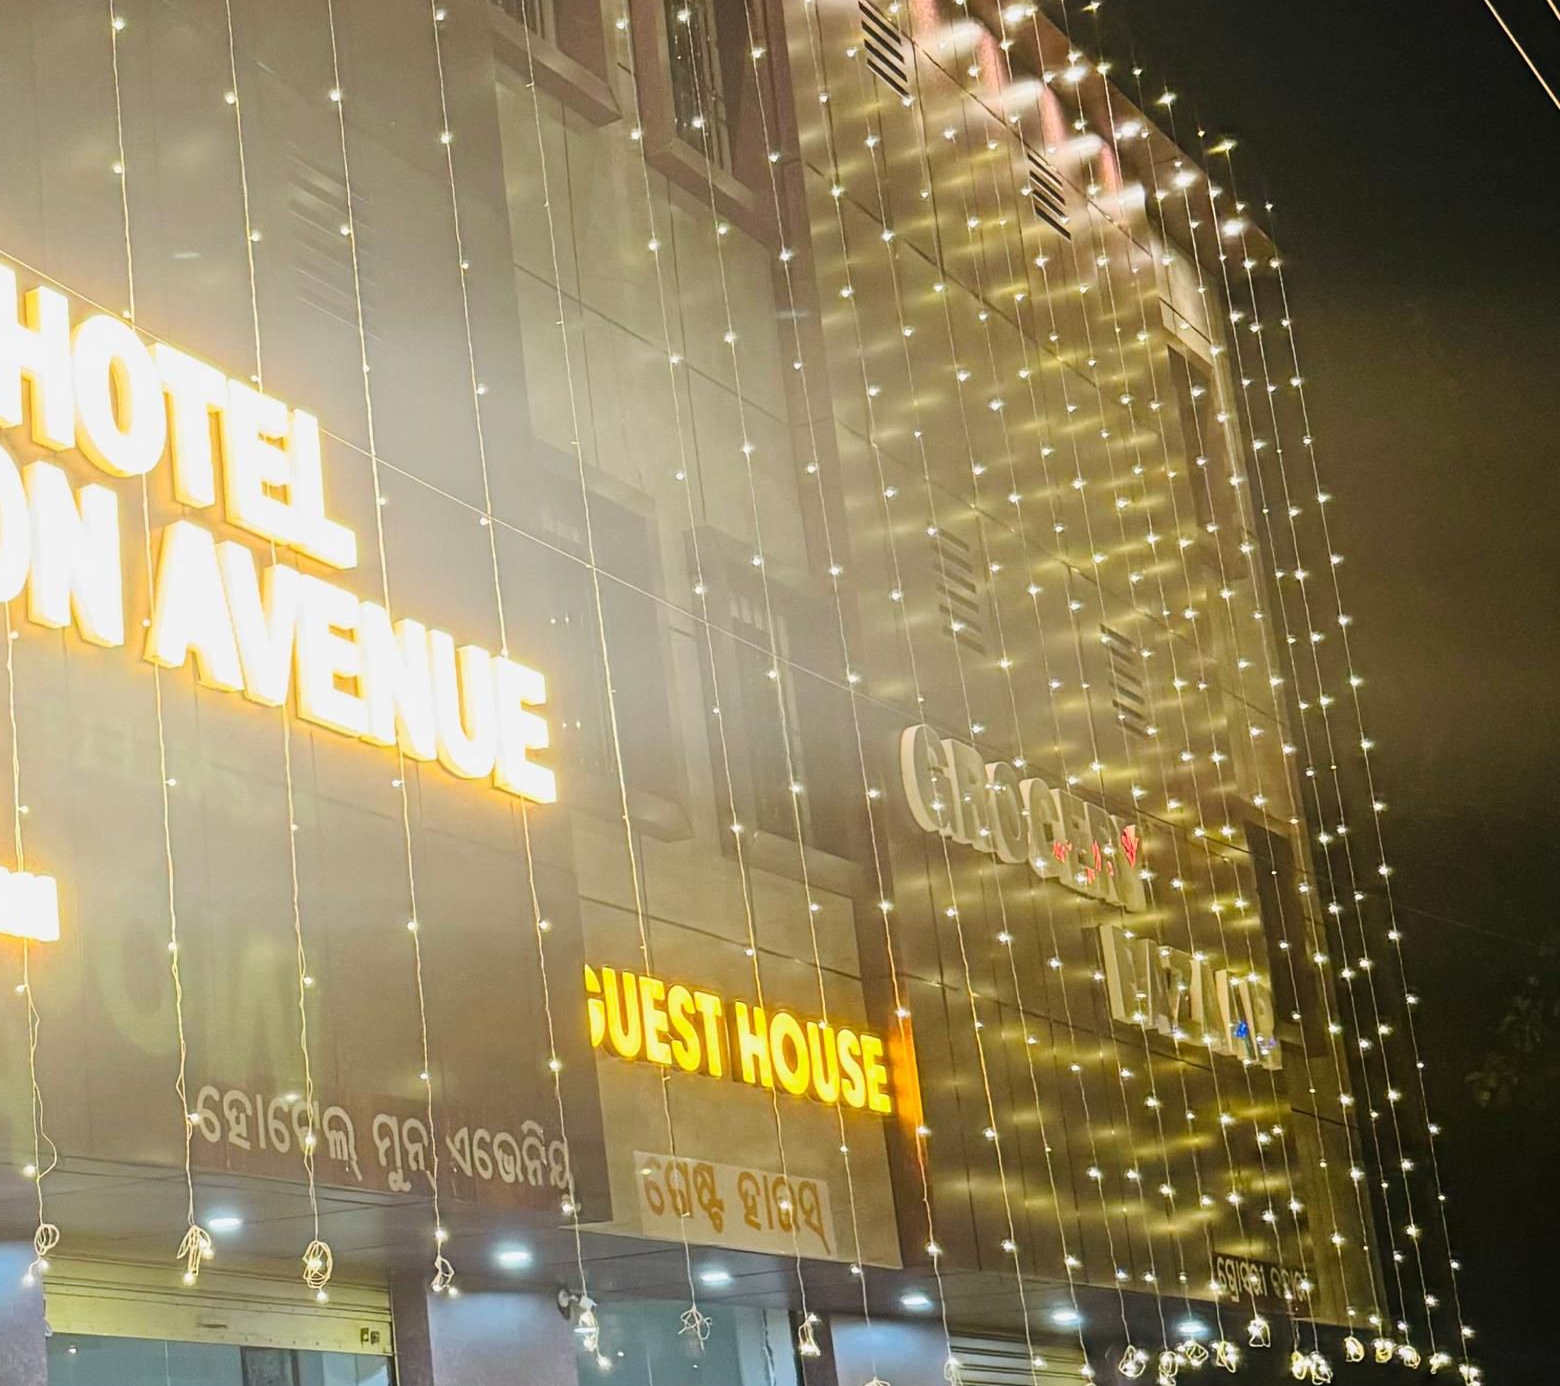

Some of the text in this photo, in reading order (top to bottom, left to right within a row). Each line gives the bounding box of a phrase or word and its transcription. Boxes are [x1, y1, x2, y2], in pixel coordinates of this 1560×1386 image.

[143, 521, 557, 803] AVENUE
[900, 723, 1147, 912] GROCERY
[733, 999, 893, 1115] HOUSE
